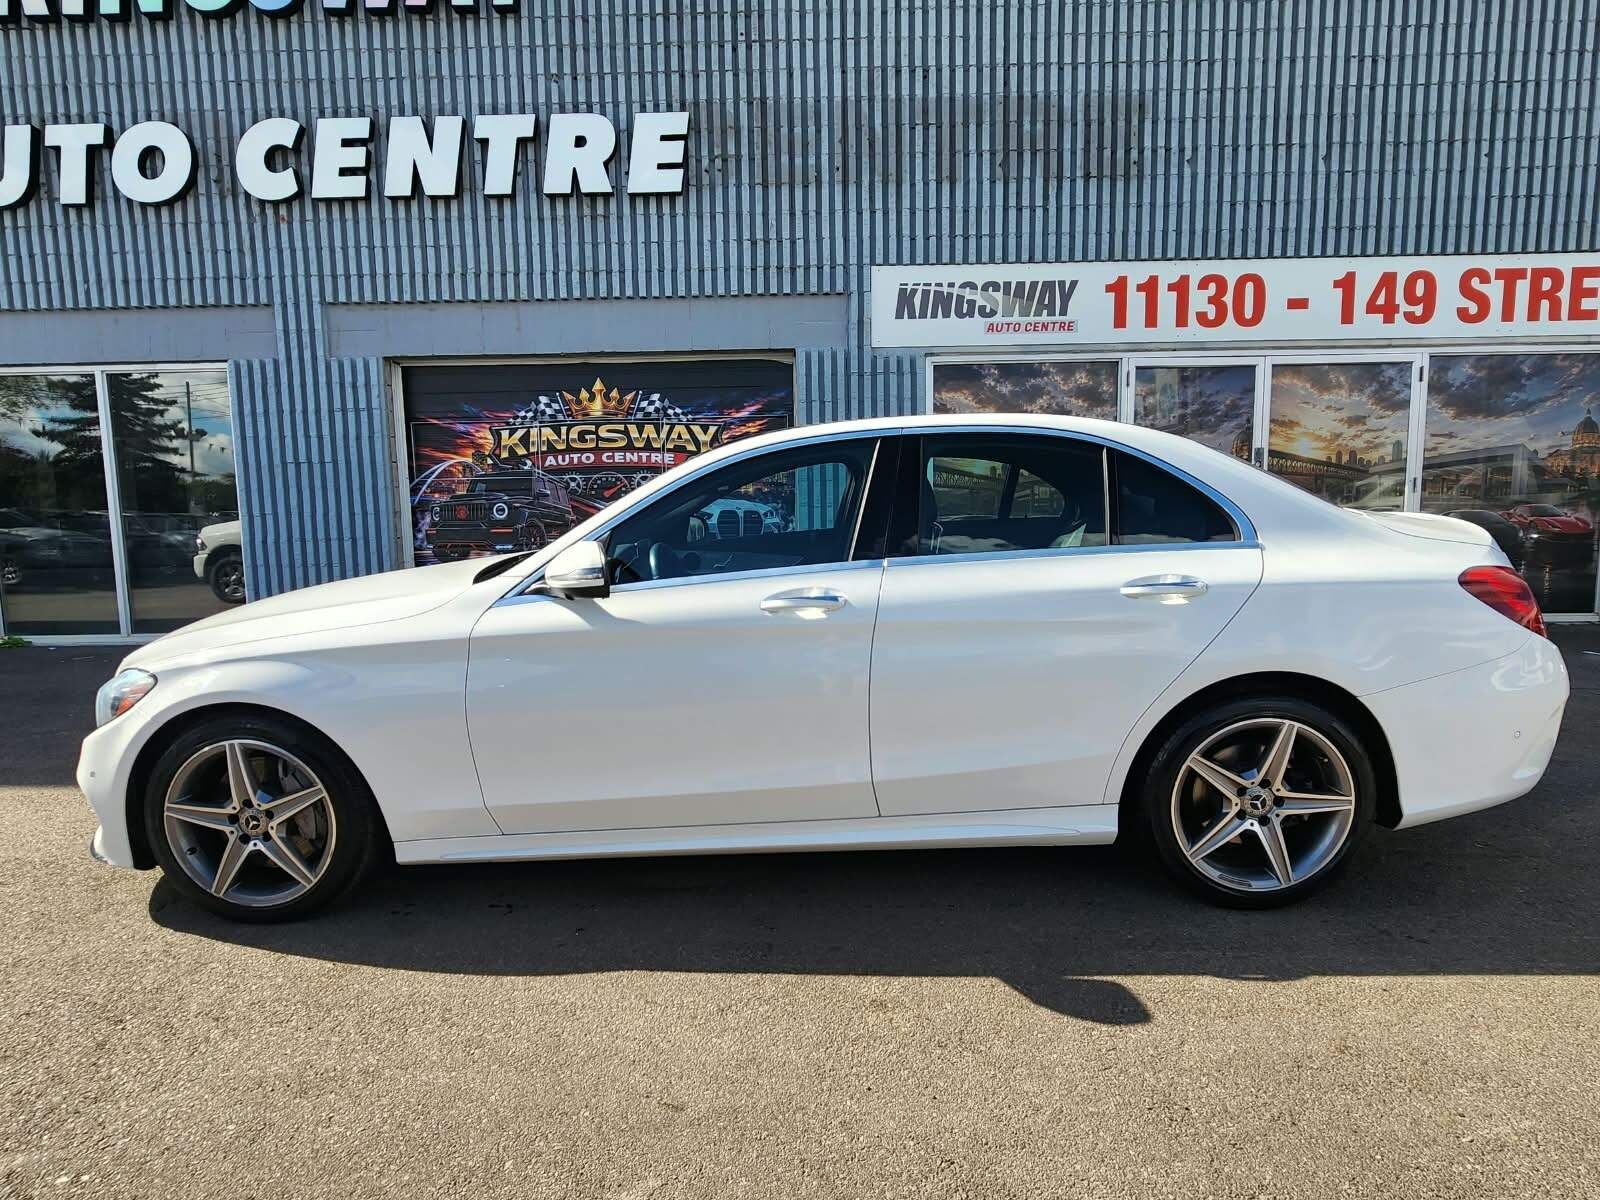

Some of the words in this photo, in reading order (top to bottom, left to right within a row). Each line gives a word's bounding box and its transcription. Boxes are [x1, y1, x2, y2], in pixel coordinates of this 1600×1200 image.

[236, 112, 690, 200] CENTRE
[894, 280, 1079, 319] KINGSWAY
[1105, 273, 1266, 328] 11130
[1333, 270, 1437, 325] 149
[1456, 266, 1600, 324] STRE
[987, 322, 1021, 333] AUTO
[1025, 321, 1075, 332] CENTRE
[500, 424, 719, 458] KINGSWAY
[544, 453, 595, 467] AUTO
[601, 451, 675, 466] CENTRE
